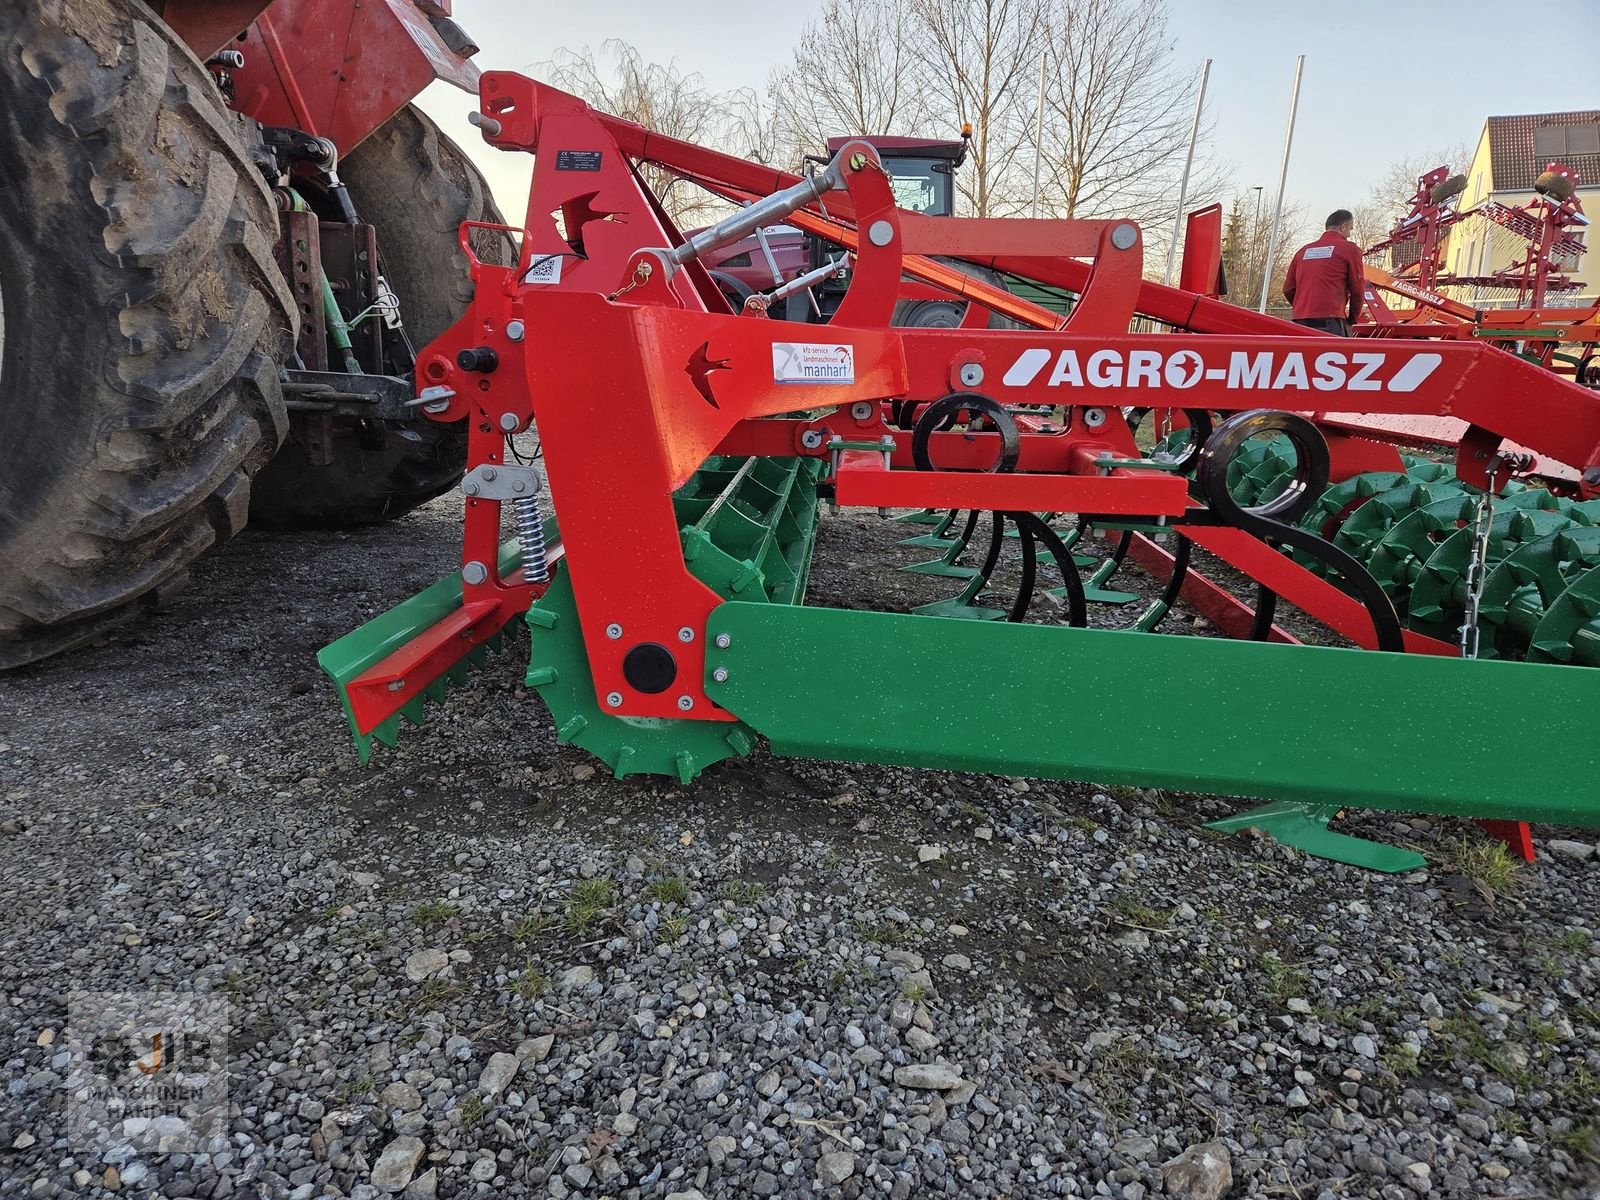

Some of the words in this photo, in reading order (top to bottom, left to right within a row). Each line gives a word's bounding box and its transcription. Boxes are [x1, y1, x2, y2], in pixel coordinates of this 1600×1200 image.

[1397, 281, 1440, 304] AGRO-MASZ
[804, 363, 848, 377] manhart
[1047, 347, 1388, 392] AGRO-MASZ
